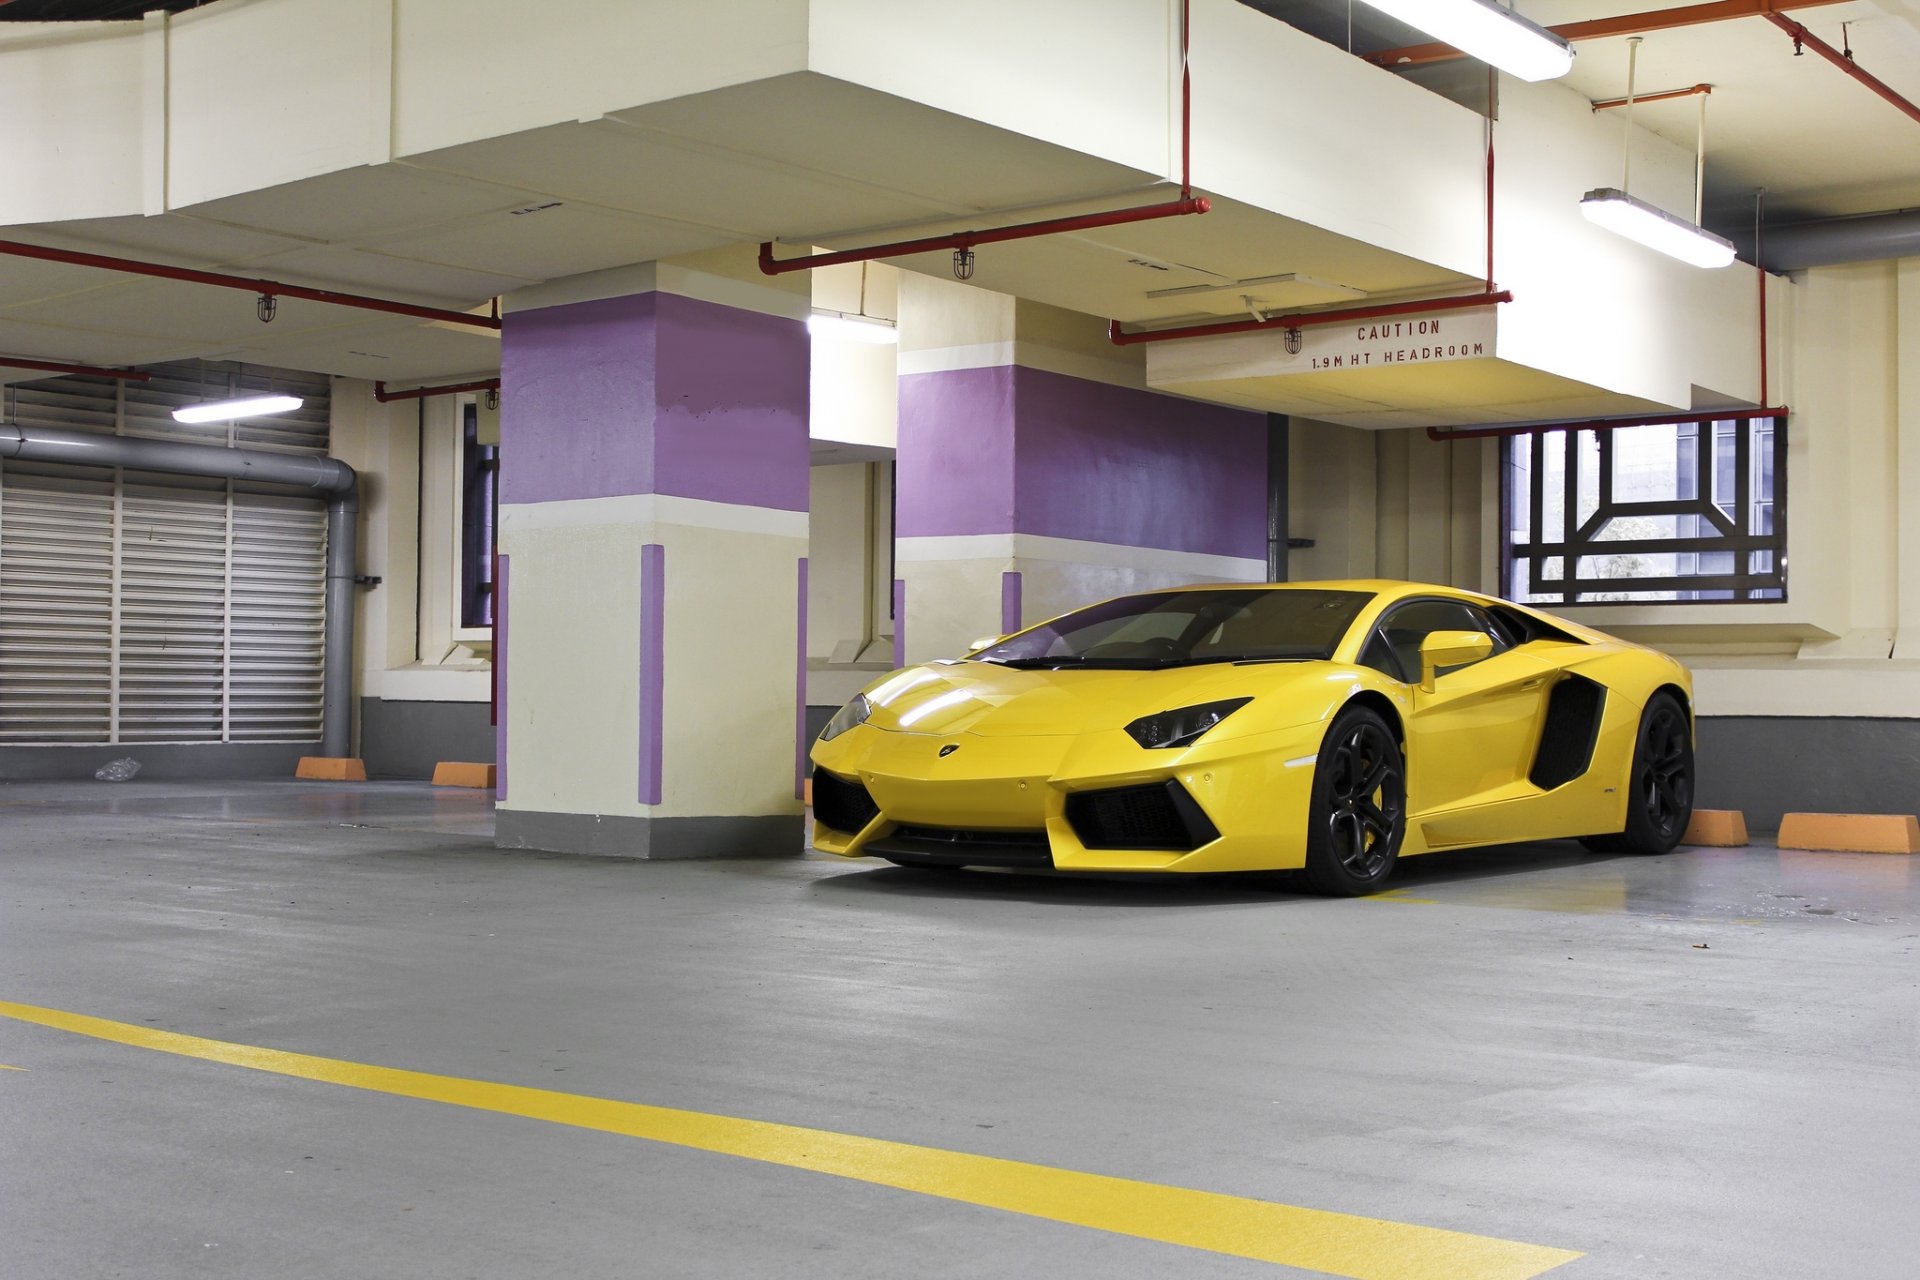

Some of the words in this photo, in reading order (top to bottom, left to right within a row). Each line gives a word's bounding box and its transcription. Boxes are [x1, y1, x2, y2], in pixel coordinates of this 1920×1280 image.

[1357, 320, 1440, 340] CAUTION
[1312, 355, 1342, 369] 1.9M
[1351, 352, 1370, 366] HT
[1384, 343, 1483, 363] HEADROOM
